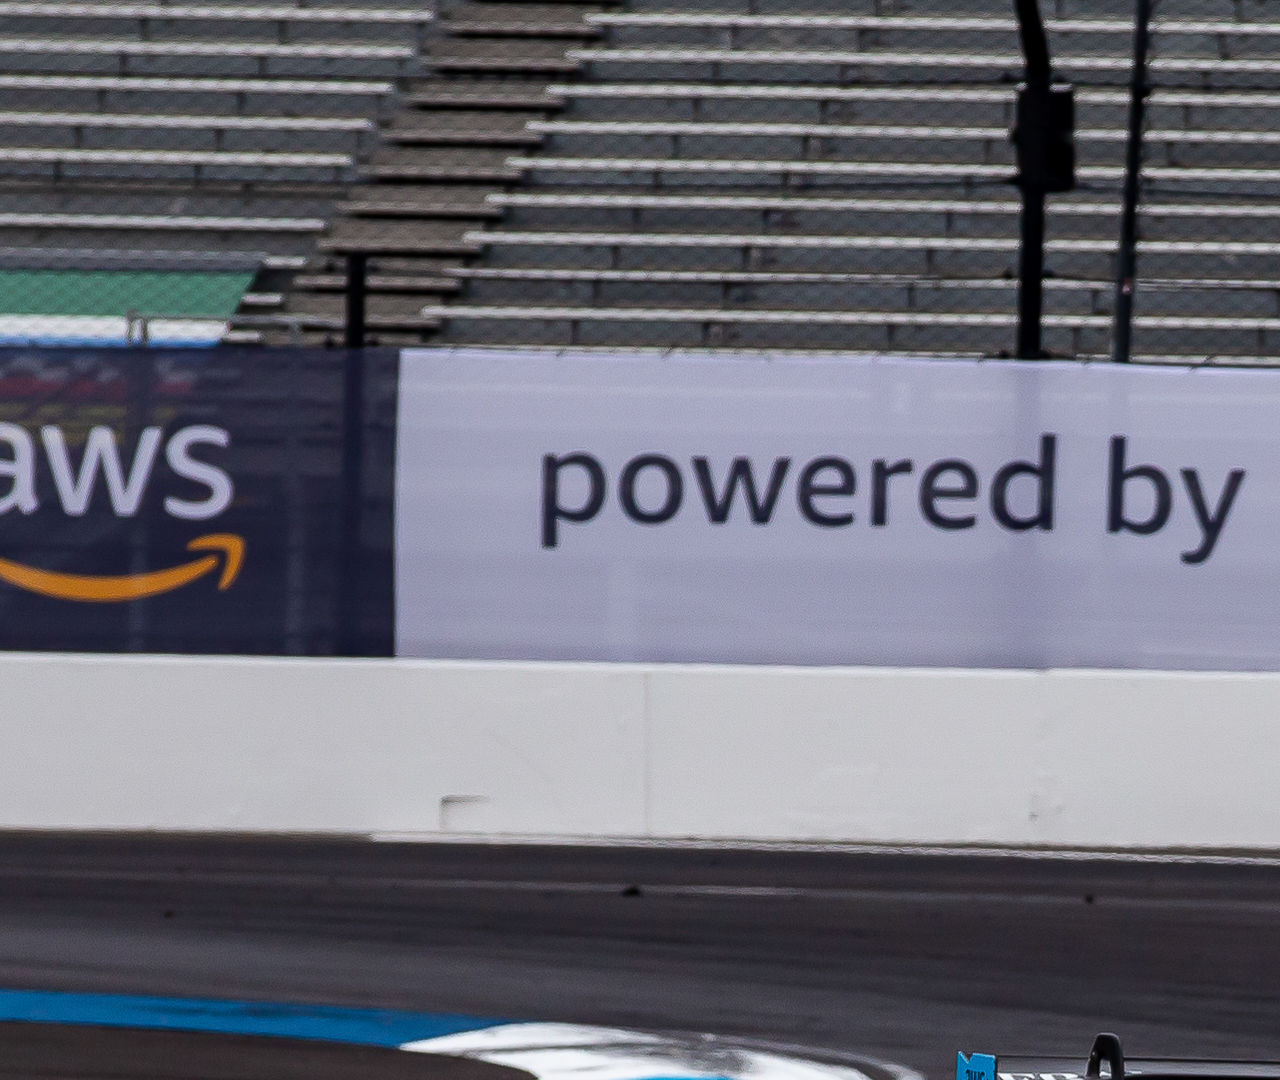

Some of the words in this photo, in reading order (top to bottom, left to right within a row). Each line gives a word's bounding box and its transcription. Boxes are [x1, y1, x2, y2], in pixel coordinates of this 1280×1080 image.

[0, 421, 235, 521] aws
[540, 433, 1058, 549] powered
[1106, 434, 1246, 565] by
